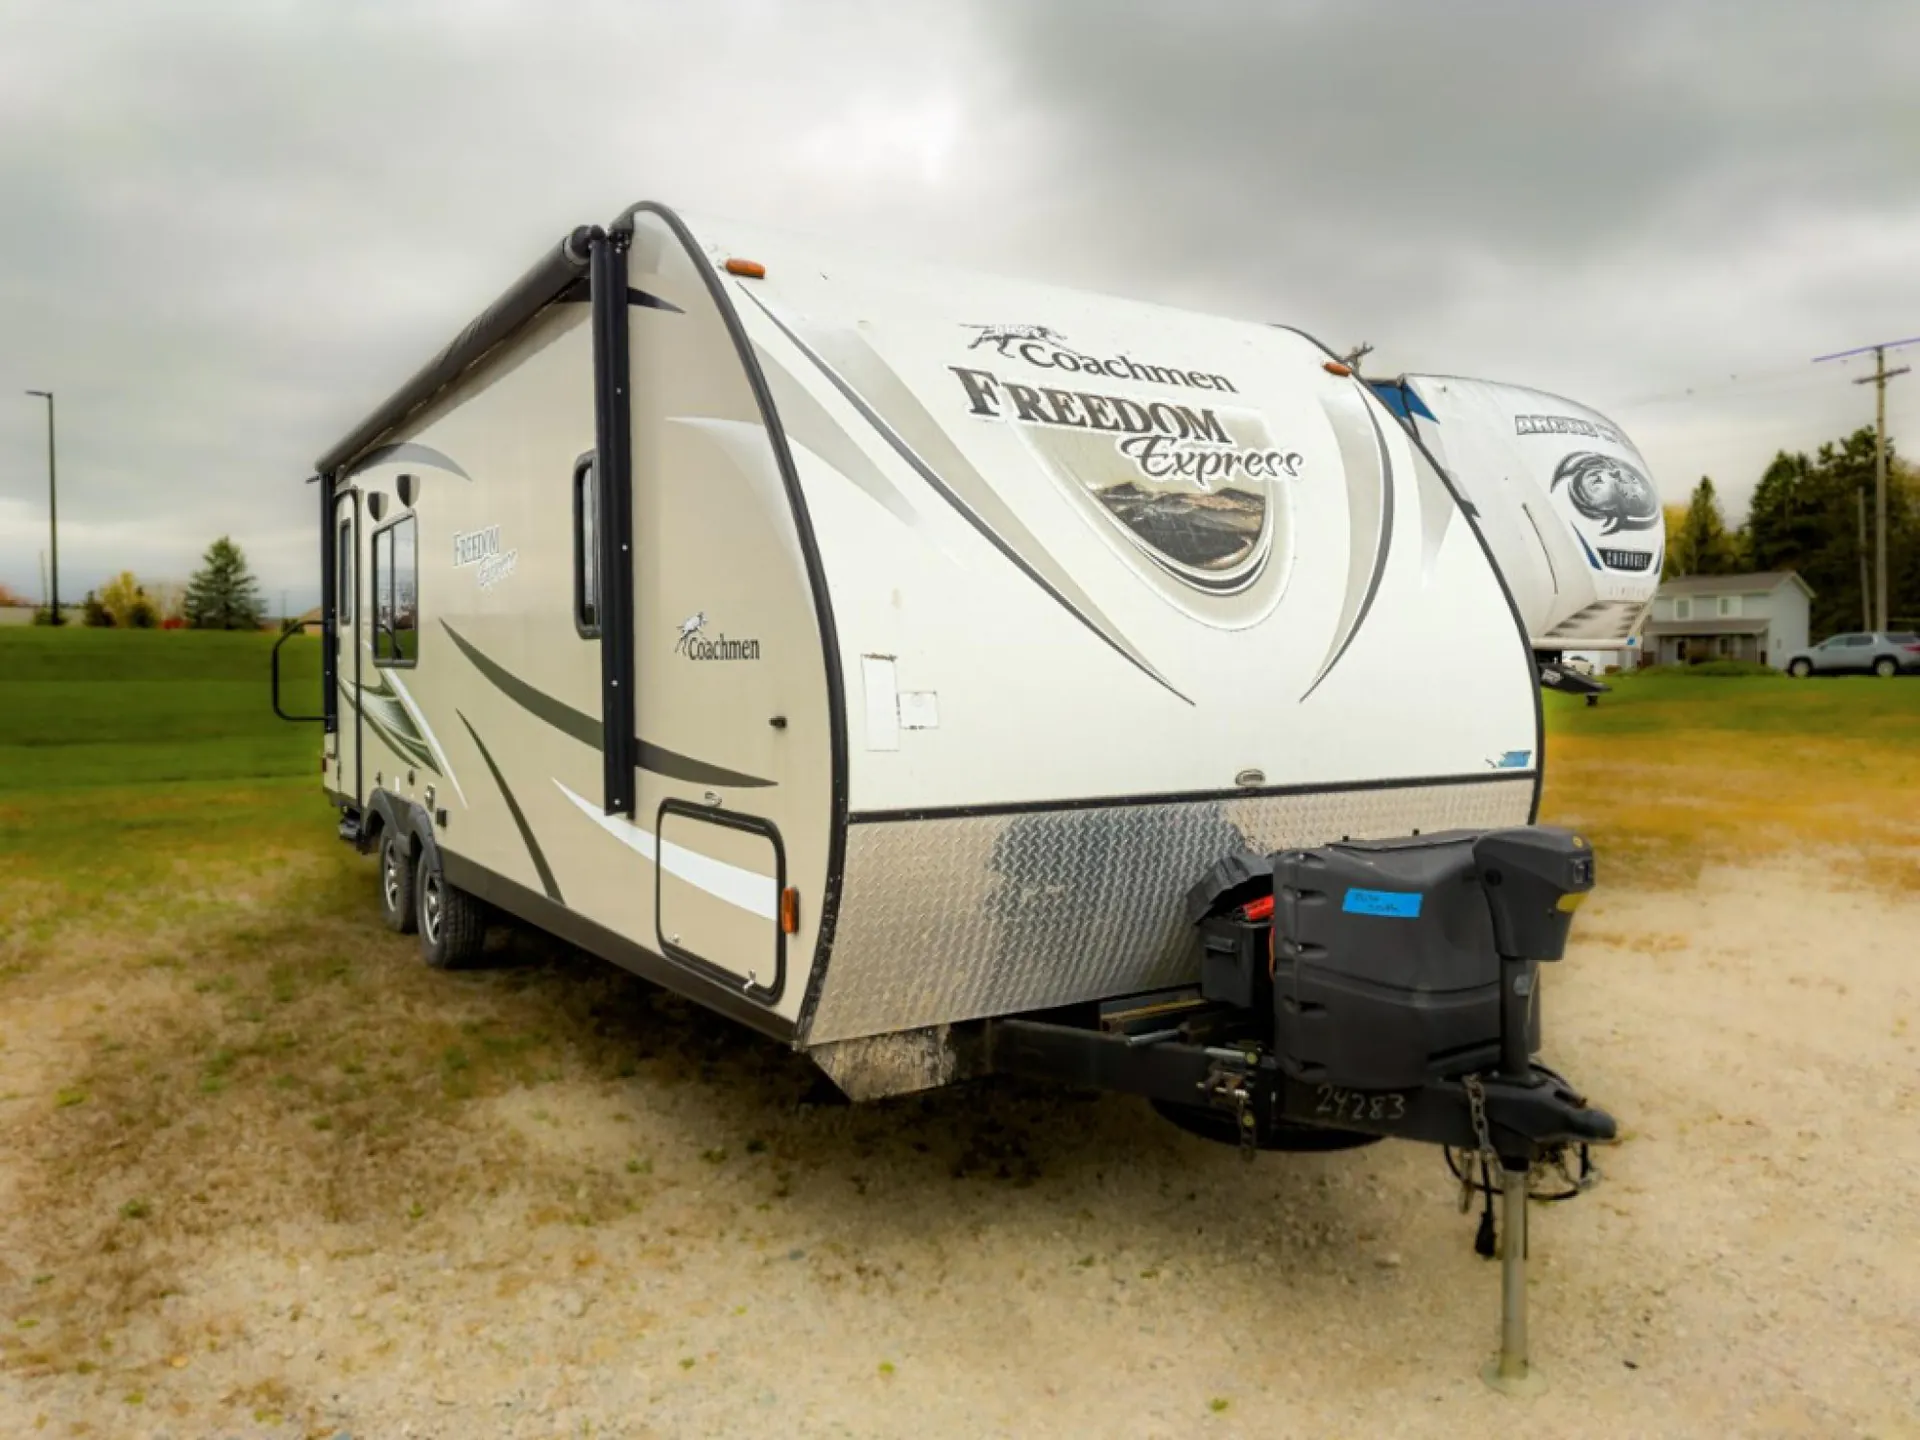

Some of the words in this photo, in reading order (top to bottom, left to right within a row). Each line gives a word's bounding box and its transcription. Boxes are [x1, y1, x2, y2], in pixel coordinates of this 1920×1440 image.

[1019, 344, 1240, 394] Coachmen
[948, 366, 1232, 444] FREEDOM
[1120, 434, 1303, 483] Express
[453, 526, 500, 567] FREEDOM
[688, 632, 760, 661] Coachmen
[1316, 1083, 1405, 1119] 24283
